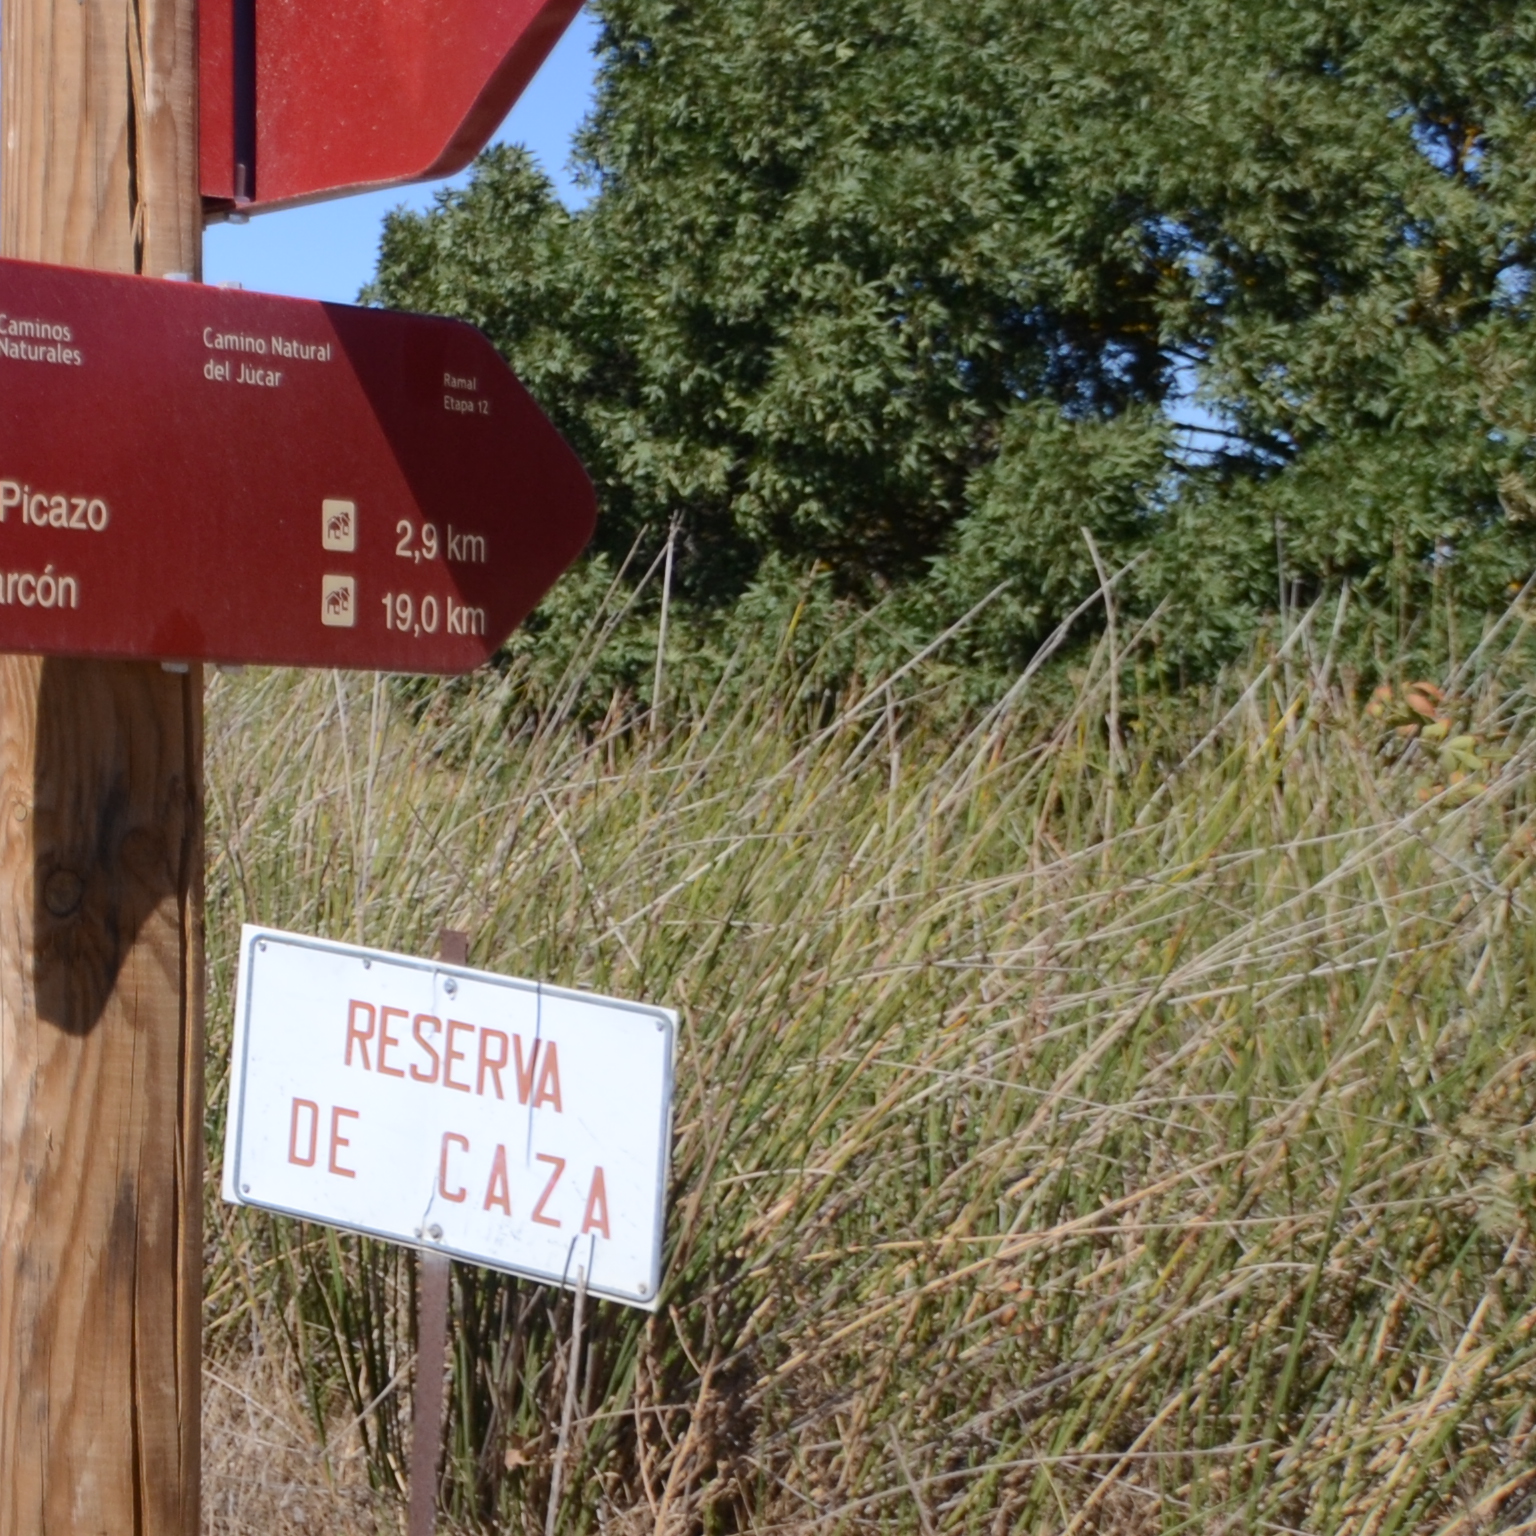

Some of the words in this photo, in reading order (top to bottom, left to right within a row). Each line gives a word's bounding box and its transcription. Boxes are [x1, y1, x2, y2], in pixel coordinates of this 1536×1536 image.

[202, 326, 266, 355] Camino
[271, 335, 331, 362] Natural
[203, 358, 230, 382] del
[236, 363, 282, 387] Júcar
[443, 372, 477, 391] Ramal
[443, 395, 475, 415] Etapa
[478, 399, 489, 415] 12
[395, 519, 438, 564] 2,9
[447, 523, 486, 563] km
[381, 592, 439, 638] 19,0
[446, 596, 486, 636] km
[344, 998, 563, 1114] RESERVA
[287, 1097, 360, 1179] DE
[438, 1131, 611, 1241] CAZA
